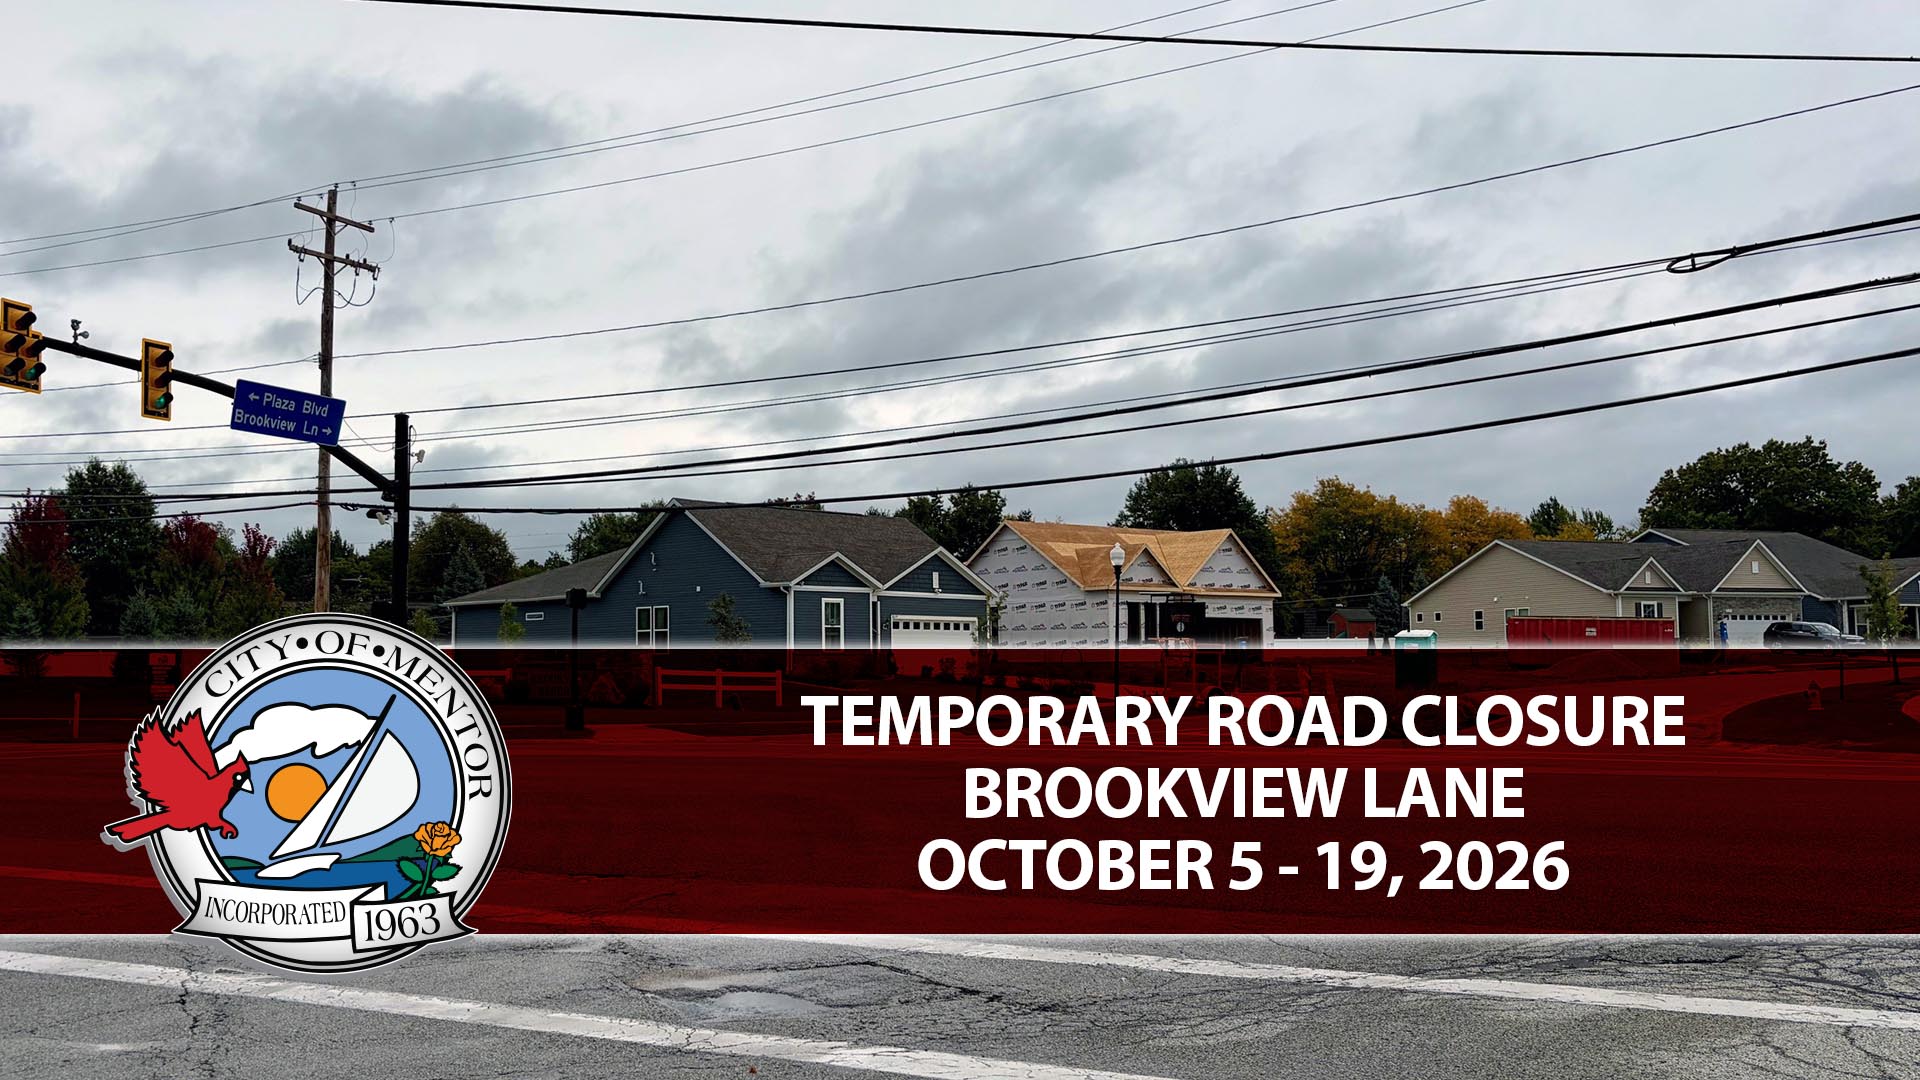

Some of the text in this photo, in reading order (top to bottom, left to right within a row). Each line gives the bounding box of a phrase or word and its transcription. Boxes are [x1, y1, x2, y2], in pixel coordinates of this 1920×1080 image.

[263, 392, 329, 417] Plaza Blvd
[234, 409, 319, 436] Brookview Ln
